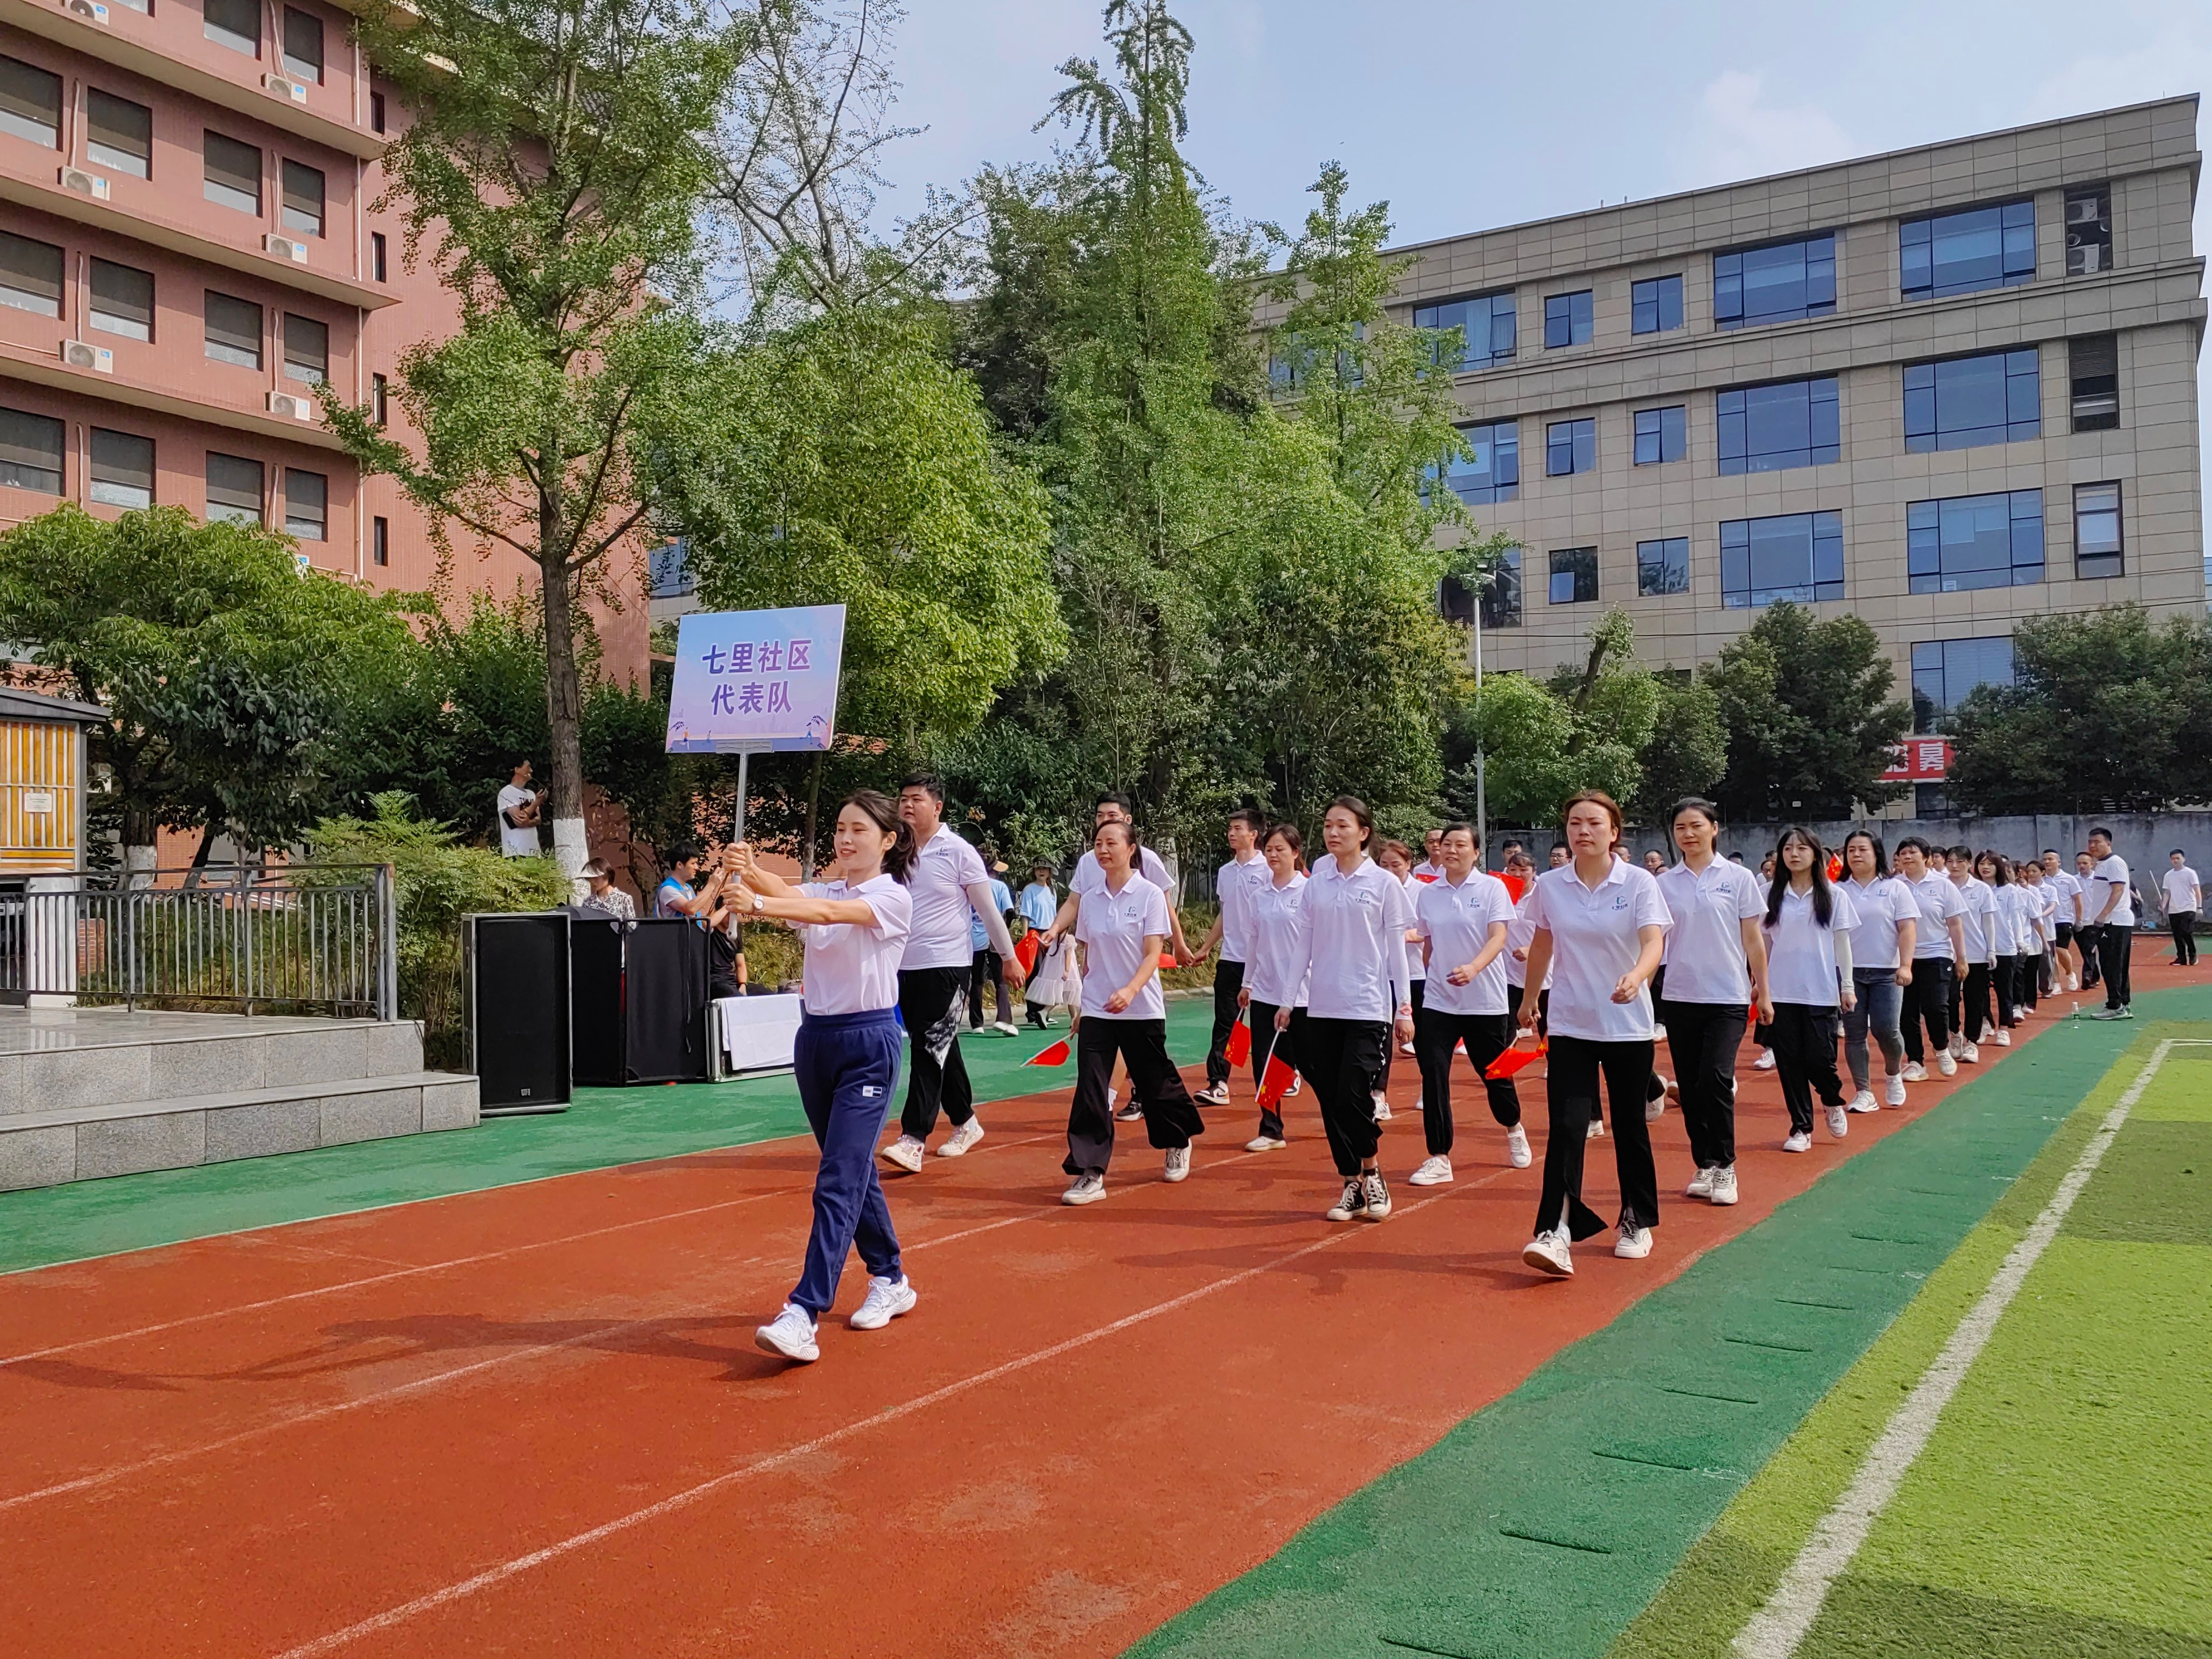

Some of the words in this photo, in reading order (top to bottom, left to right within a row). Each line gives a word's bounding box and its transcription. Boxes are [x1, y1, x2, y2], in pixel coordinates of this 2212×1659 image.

[702, 639, 812, 674] 七里社区
[711, 680, 792, 716] 代表队
